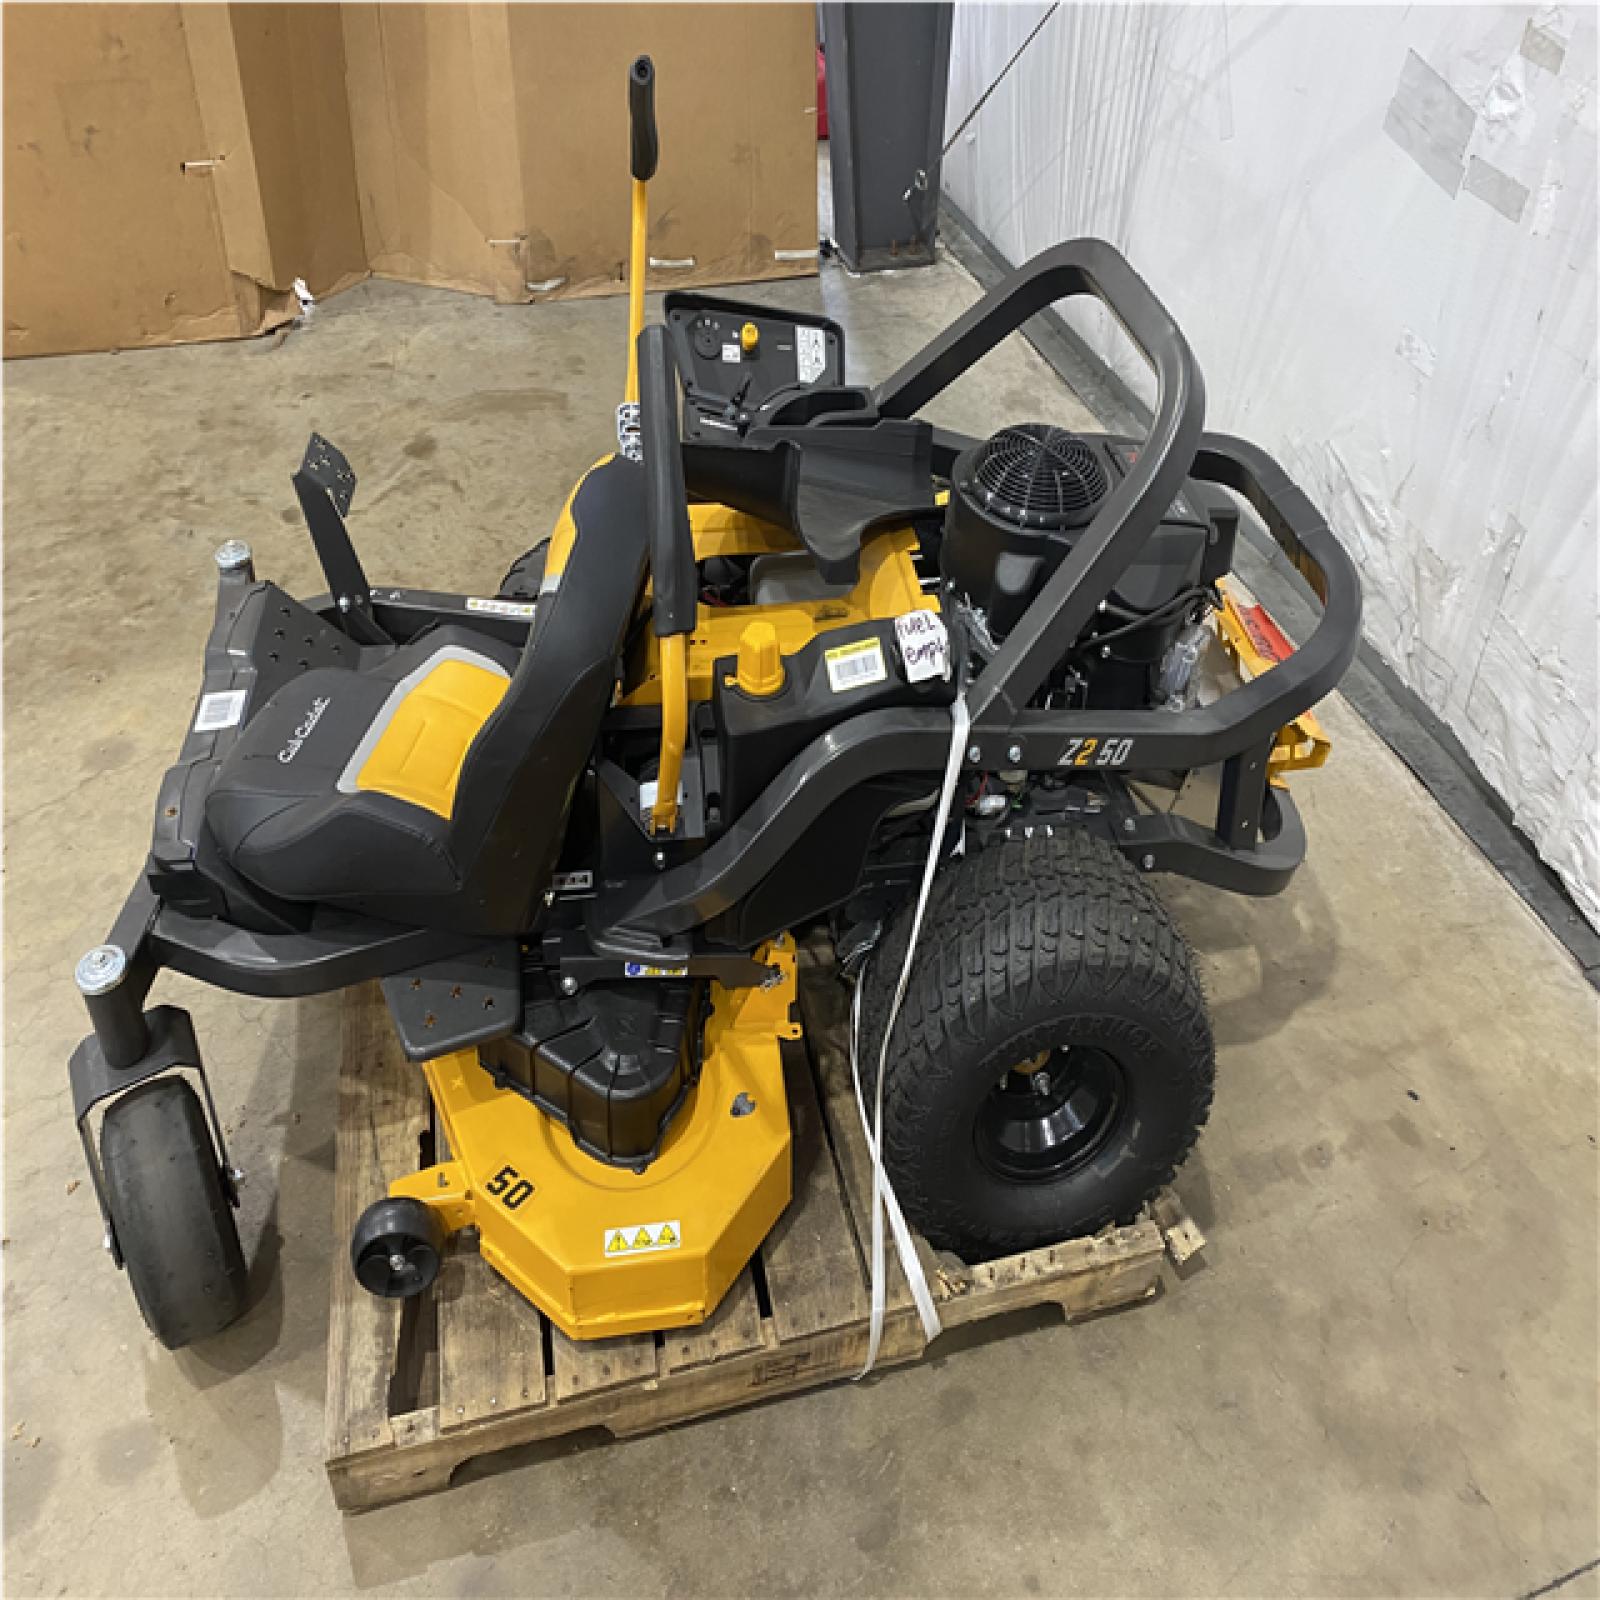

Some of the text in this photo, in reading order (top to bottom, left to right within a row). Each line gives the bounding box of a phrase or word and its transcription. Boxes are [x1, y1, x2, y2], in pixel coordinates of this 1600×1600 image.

[277, 696, 331, 764] Cub Cadet
[486, 1164, 535, 1210] 50
